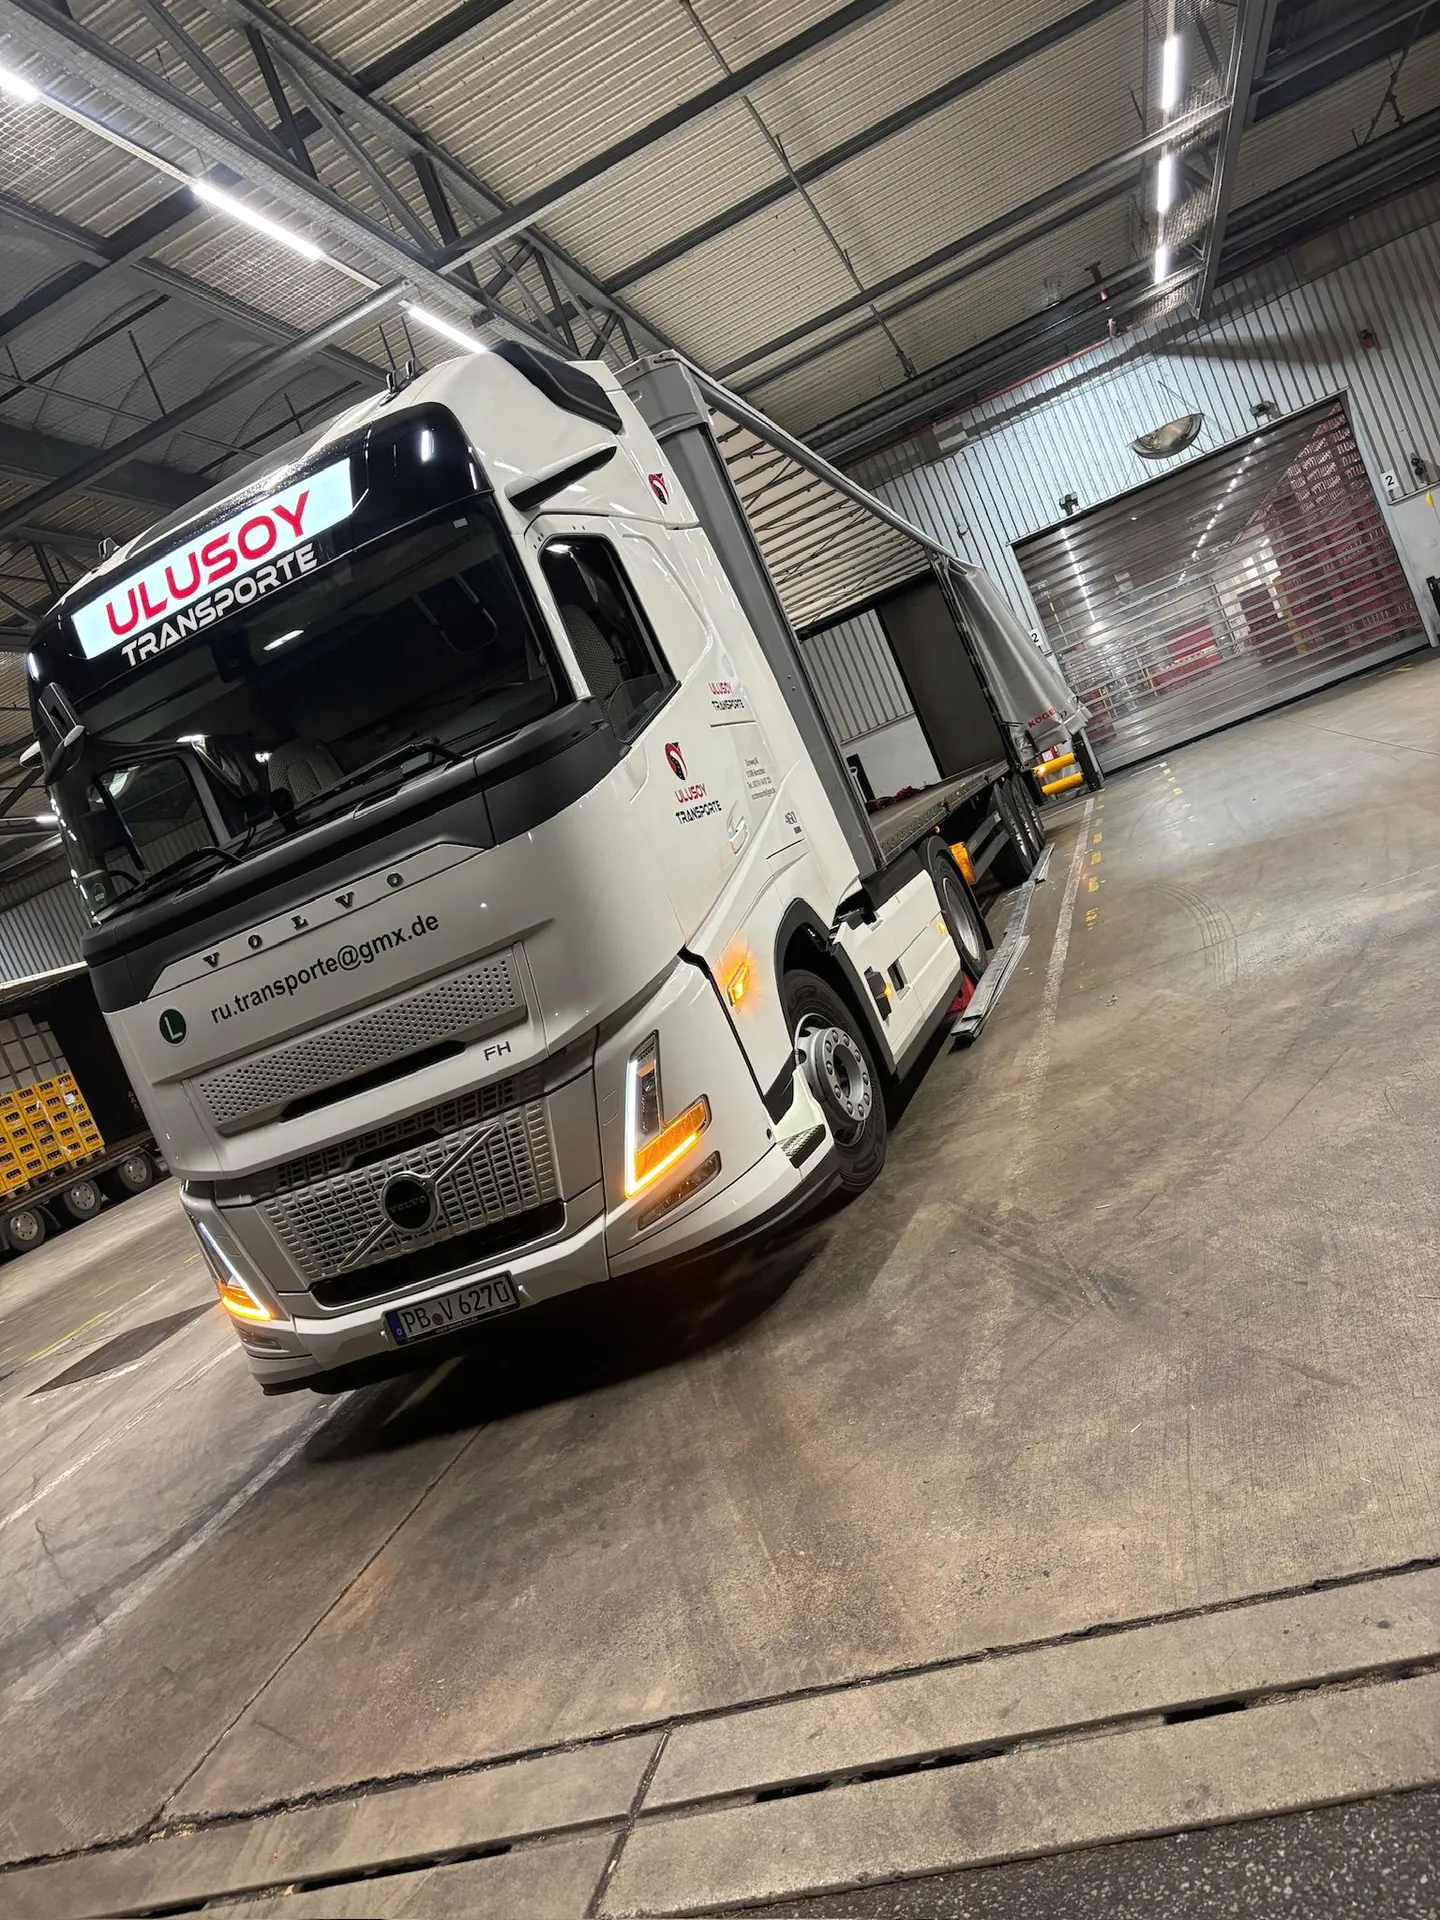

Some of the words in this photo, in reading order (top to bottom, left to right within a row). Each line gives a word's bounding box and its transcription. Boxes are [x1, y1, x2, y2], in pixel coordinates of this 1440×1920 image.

[1385, 475, 1395, 486] 2
[106, 490, 310, 636] ULUSOY
[121, 543, 318, 667] TRANSPORTE
[1031, 633, 1039, 643] 2
[708, 682, 733, 695] ULUSOY
[711, 699, 745, 711] TRANSPORTE
[674, 783, 708, 803] ULUSOY
[675, 800, 722, 824] TRANSPORTE
[203, 872, 404, 968] VOLVO
[210, 913, 440, 1024] ru.transporte@gmx.de
[163, 1016, 184, 1040] L
[483, 1041, 512, 1061] FH
[389, 1195, 428, 1214] VOLVO
[401, 1307, 431, 1334] PB
[438, 1298, 453, 1321] V
[459, 1280, 511, 1315] 6270
